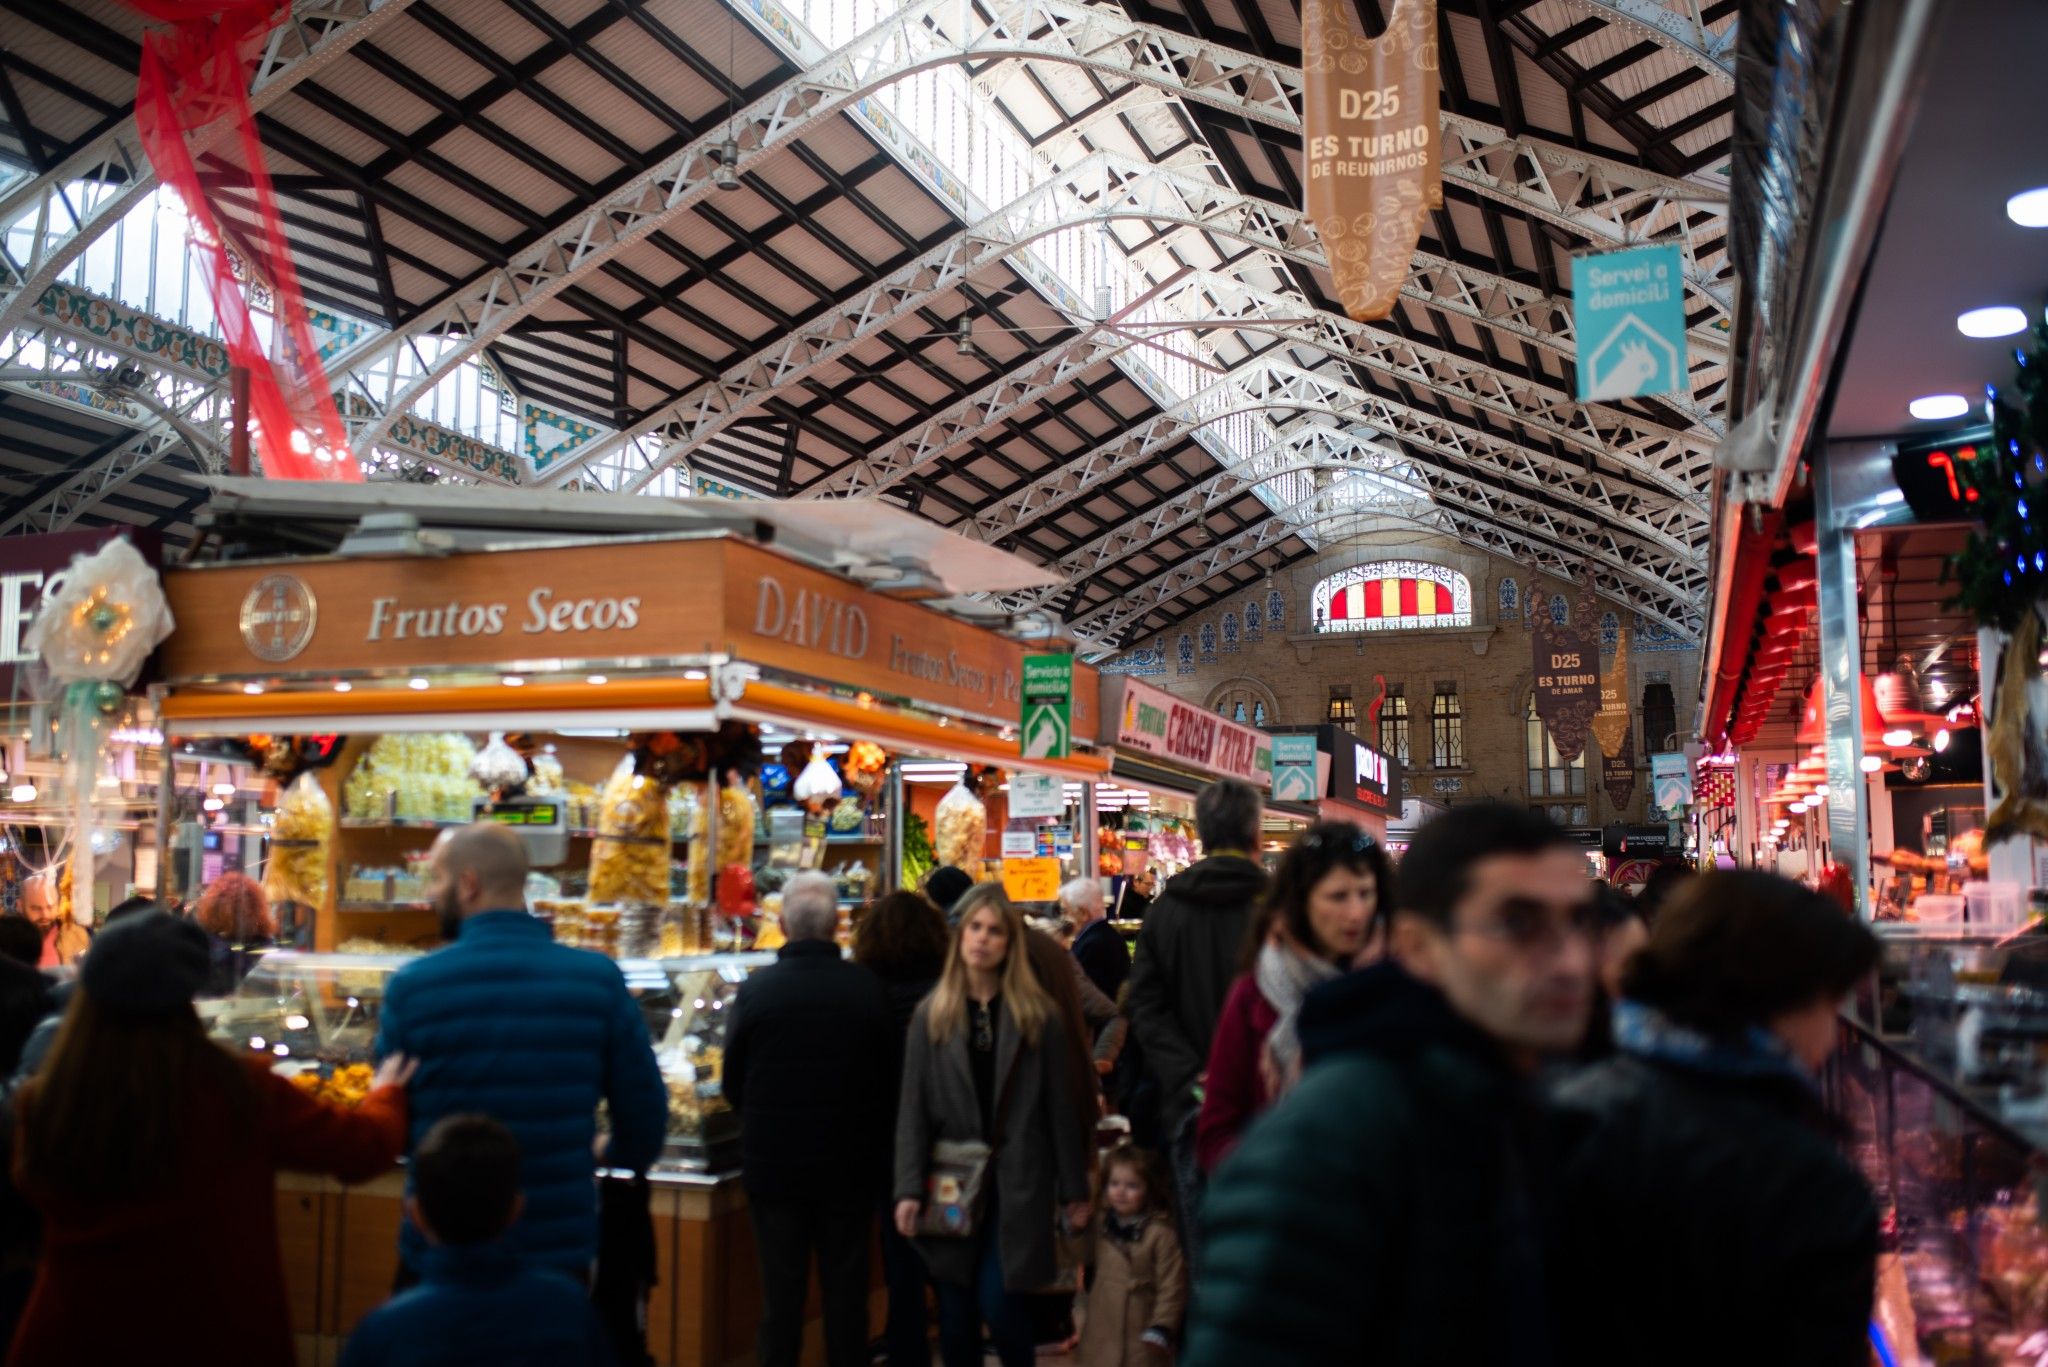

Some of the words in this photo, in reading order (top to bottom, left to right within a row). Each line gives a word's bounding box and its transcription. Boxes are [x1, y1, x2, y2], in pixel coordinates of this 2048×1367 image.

[1340, 85, 1400, 121] D25
[1310, 134, 1340, 160] ES
[1348, 124, 1430, 158] TURNO
[1312, 161, 1331, 179] DE
[1337, 151, 1429, 177] REUNIRNOS
[1589, 264, 1650, 288] Servei
[1656, 264, 1668, 279] a
[1590, 283, 1670, 310] domicili
[367, 596, 508, 641] Frutos
[522, 586, 642, 634] Secos
[755, 575, 869, 660] DAVID
[891, 634, 945, 683] Frutos
[949, 650, 986, 693] Secos
[988, 674, 999, 708] y
[1025, 664, 1063, 679] Servicio
[1552, 654, 1581, 669] D25
[1539, 677, 1553, 687] ES
[1557, 675, 1595, 686] TURNO
[1602, 703, 1627, 711] TURNO
[1611, 760, 1626, 768] D25
